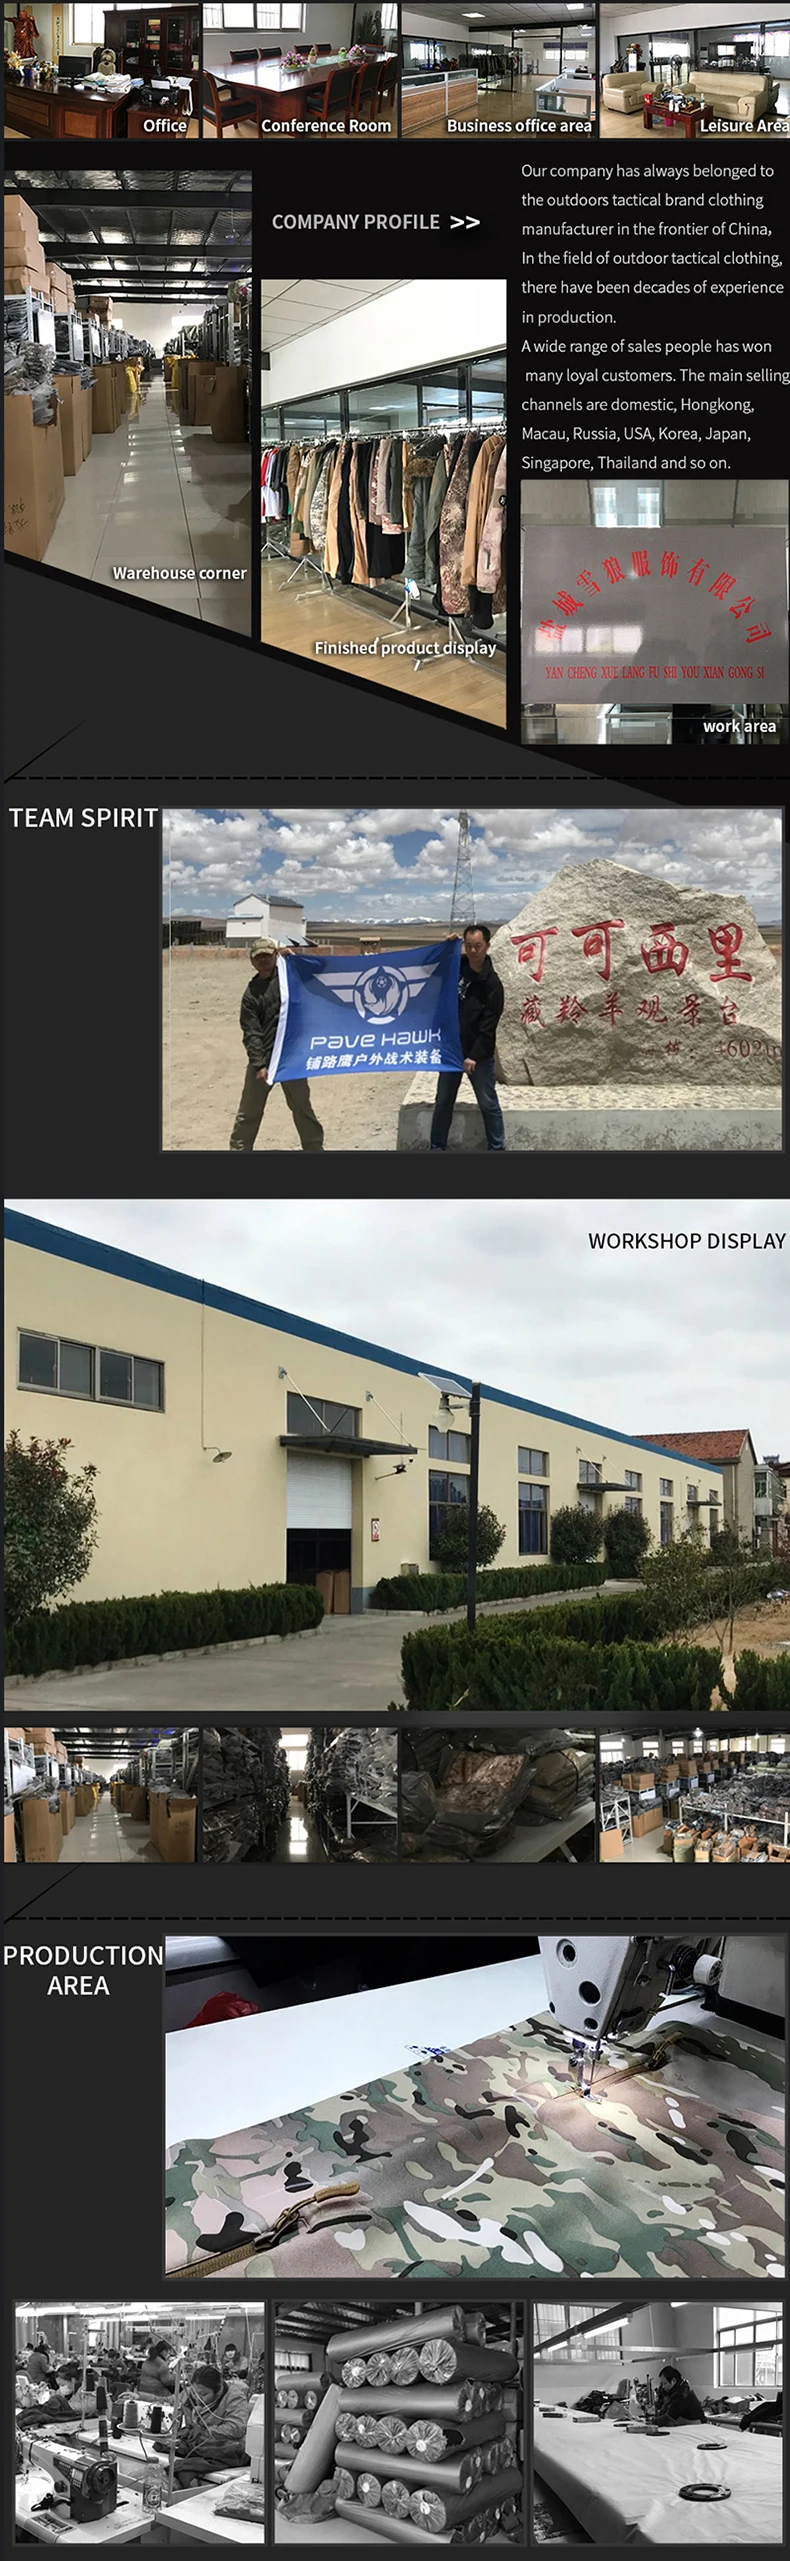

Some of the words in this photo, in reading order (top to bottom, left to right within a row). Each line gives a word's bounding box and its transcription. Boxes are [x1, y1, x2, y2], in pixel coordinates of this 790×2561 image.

[545, 666, 565, 679] YAN
[566, 666, 598, 679] CHENG
[600, 666, 619, 679] XUE
[621, 666, 646, 679] LANG
[648, 666, 661, 679] FU
[663, 666, 678, 679] SHI
[680, 666, 701, 679] YOU
[703, 666, 725, 679] XIAN
[727, 666, 754, 679] GONG
[756, 666, 766, 679] SI
[511, 918, 753, 983] 可可西里
[520, 992, 739, 1028] 藏羚羊观景台
[305, 1049, 442, 1071] 铺路鹰户外战术装备
